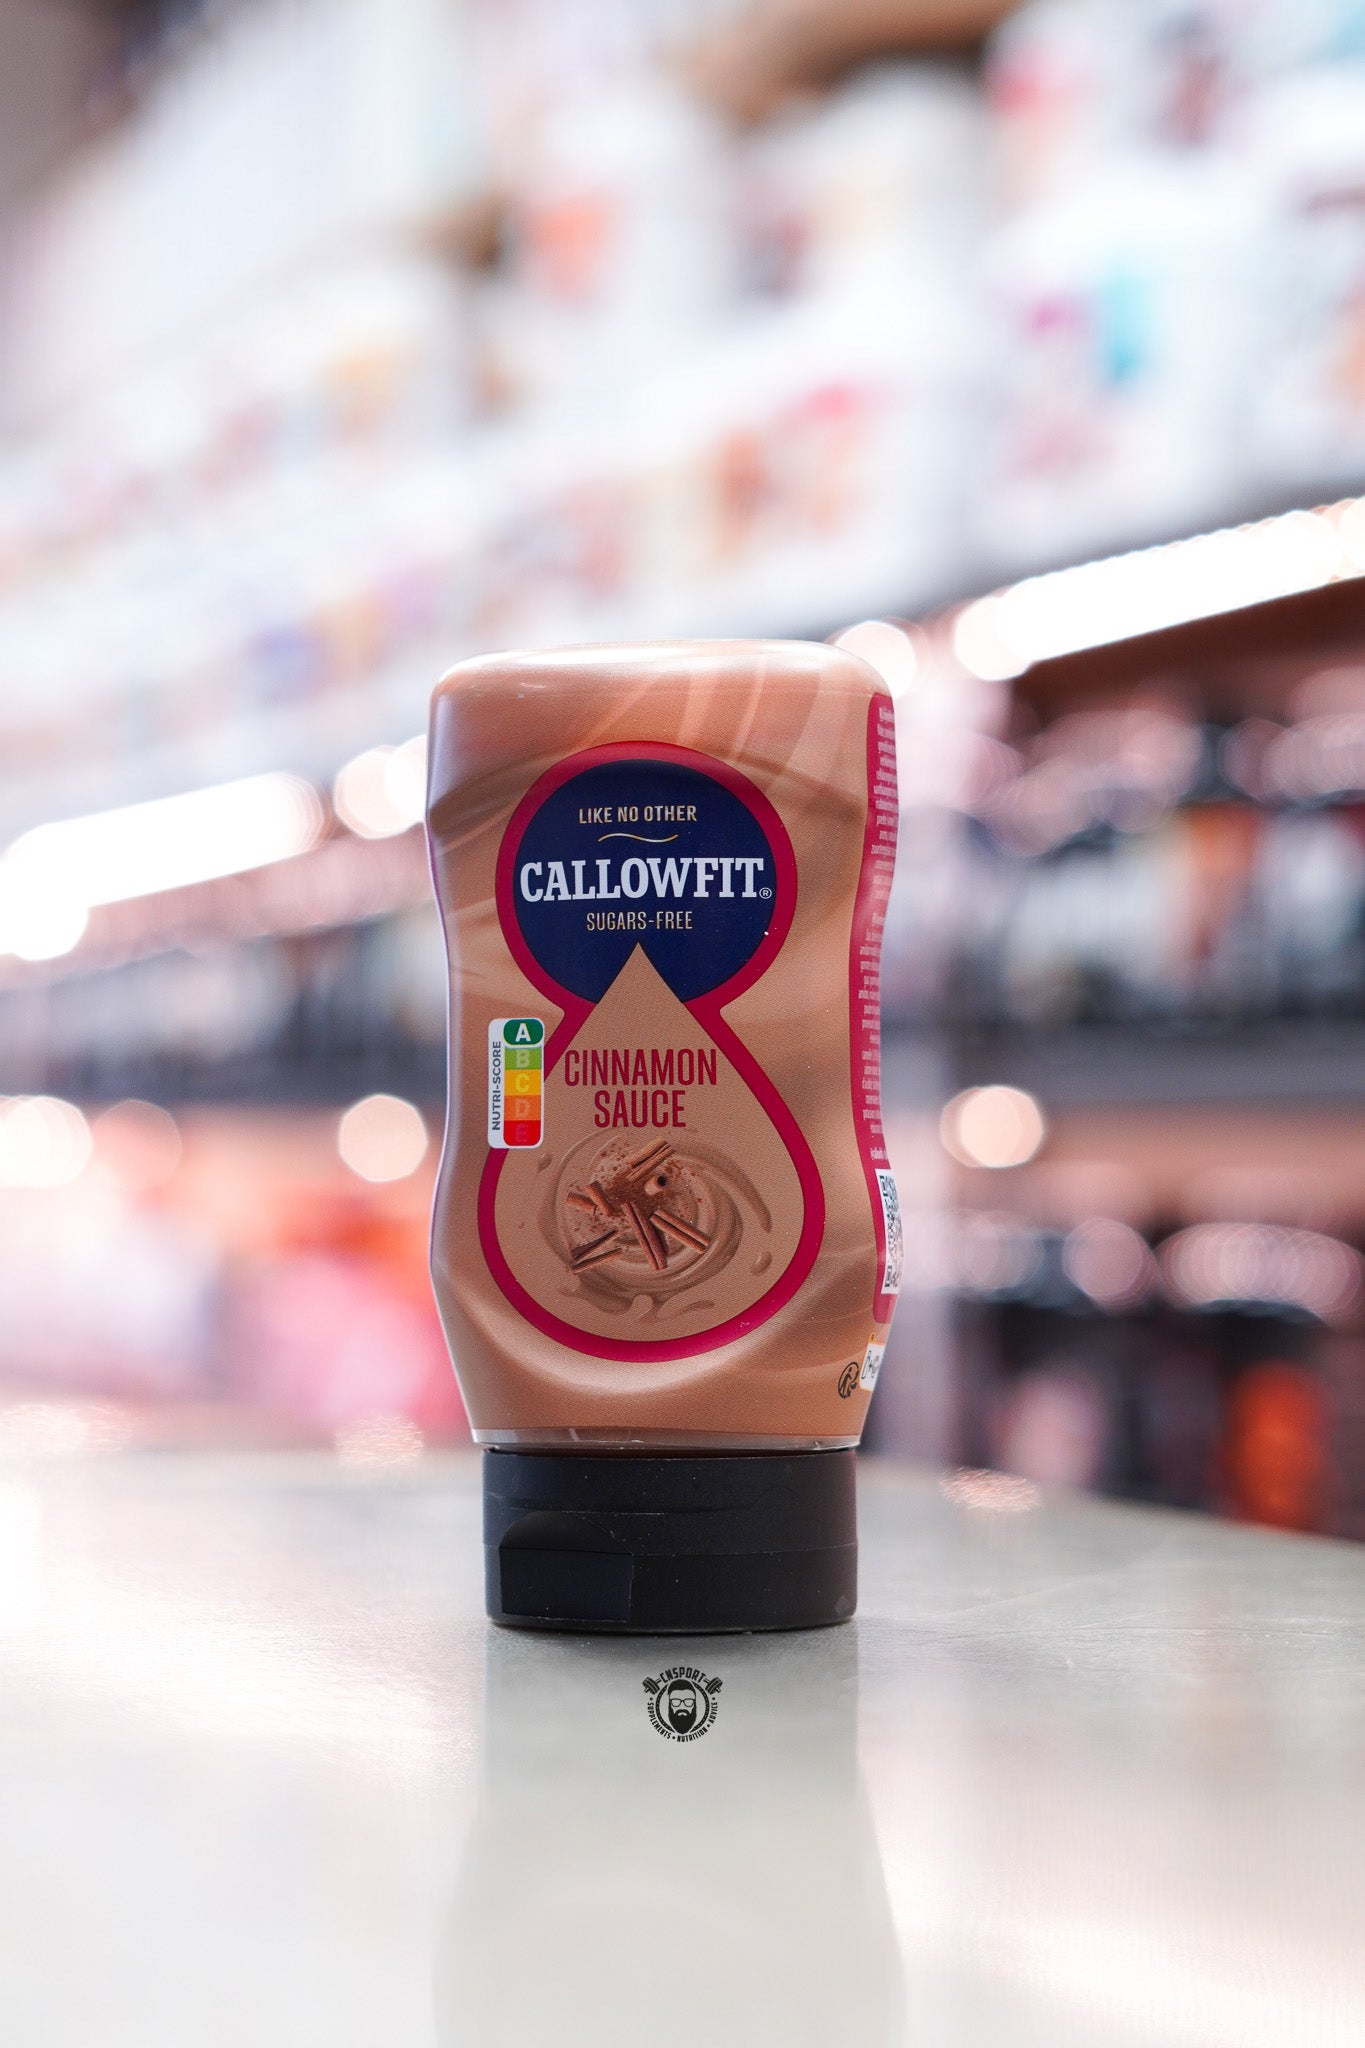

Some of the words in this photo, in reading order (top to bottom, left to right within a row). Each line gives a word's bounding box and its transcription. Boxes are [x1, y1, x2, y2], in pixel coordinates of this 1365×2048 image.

[579, 807, 612, 824] LIKE
[618, 806, 639, 822] NO
[644, 805, 697, 822] OTHER
[586, 911, 693, 931] SUGARS-FREE
[515, 1023, 531, 1041] A
[564, 1049, 717, 1086] CINNAMON
[492, 1041, 502, 1131] NUTRI-SCORE
[594, 1090, 686, 1128] SAUCE
